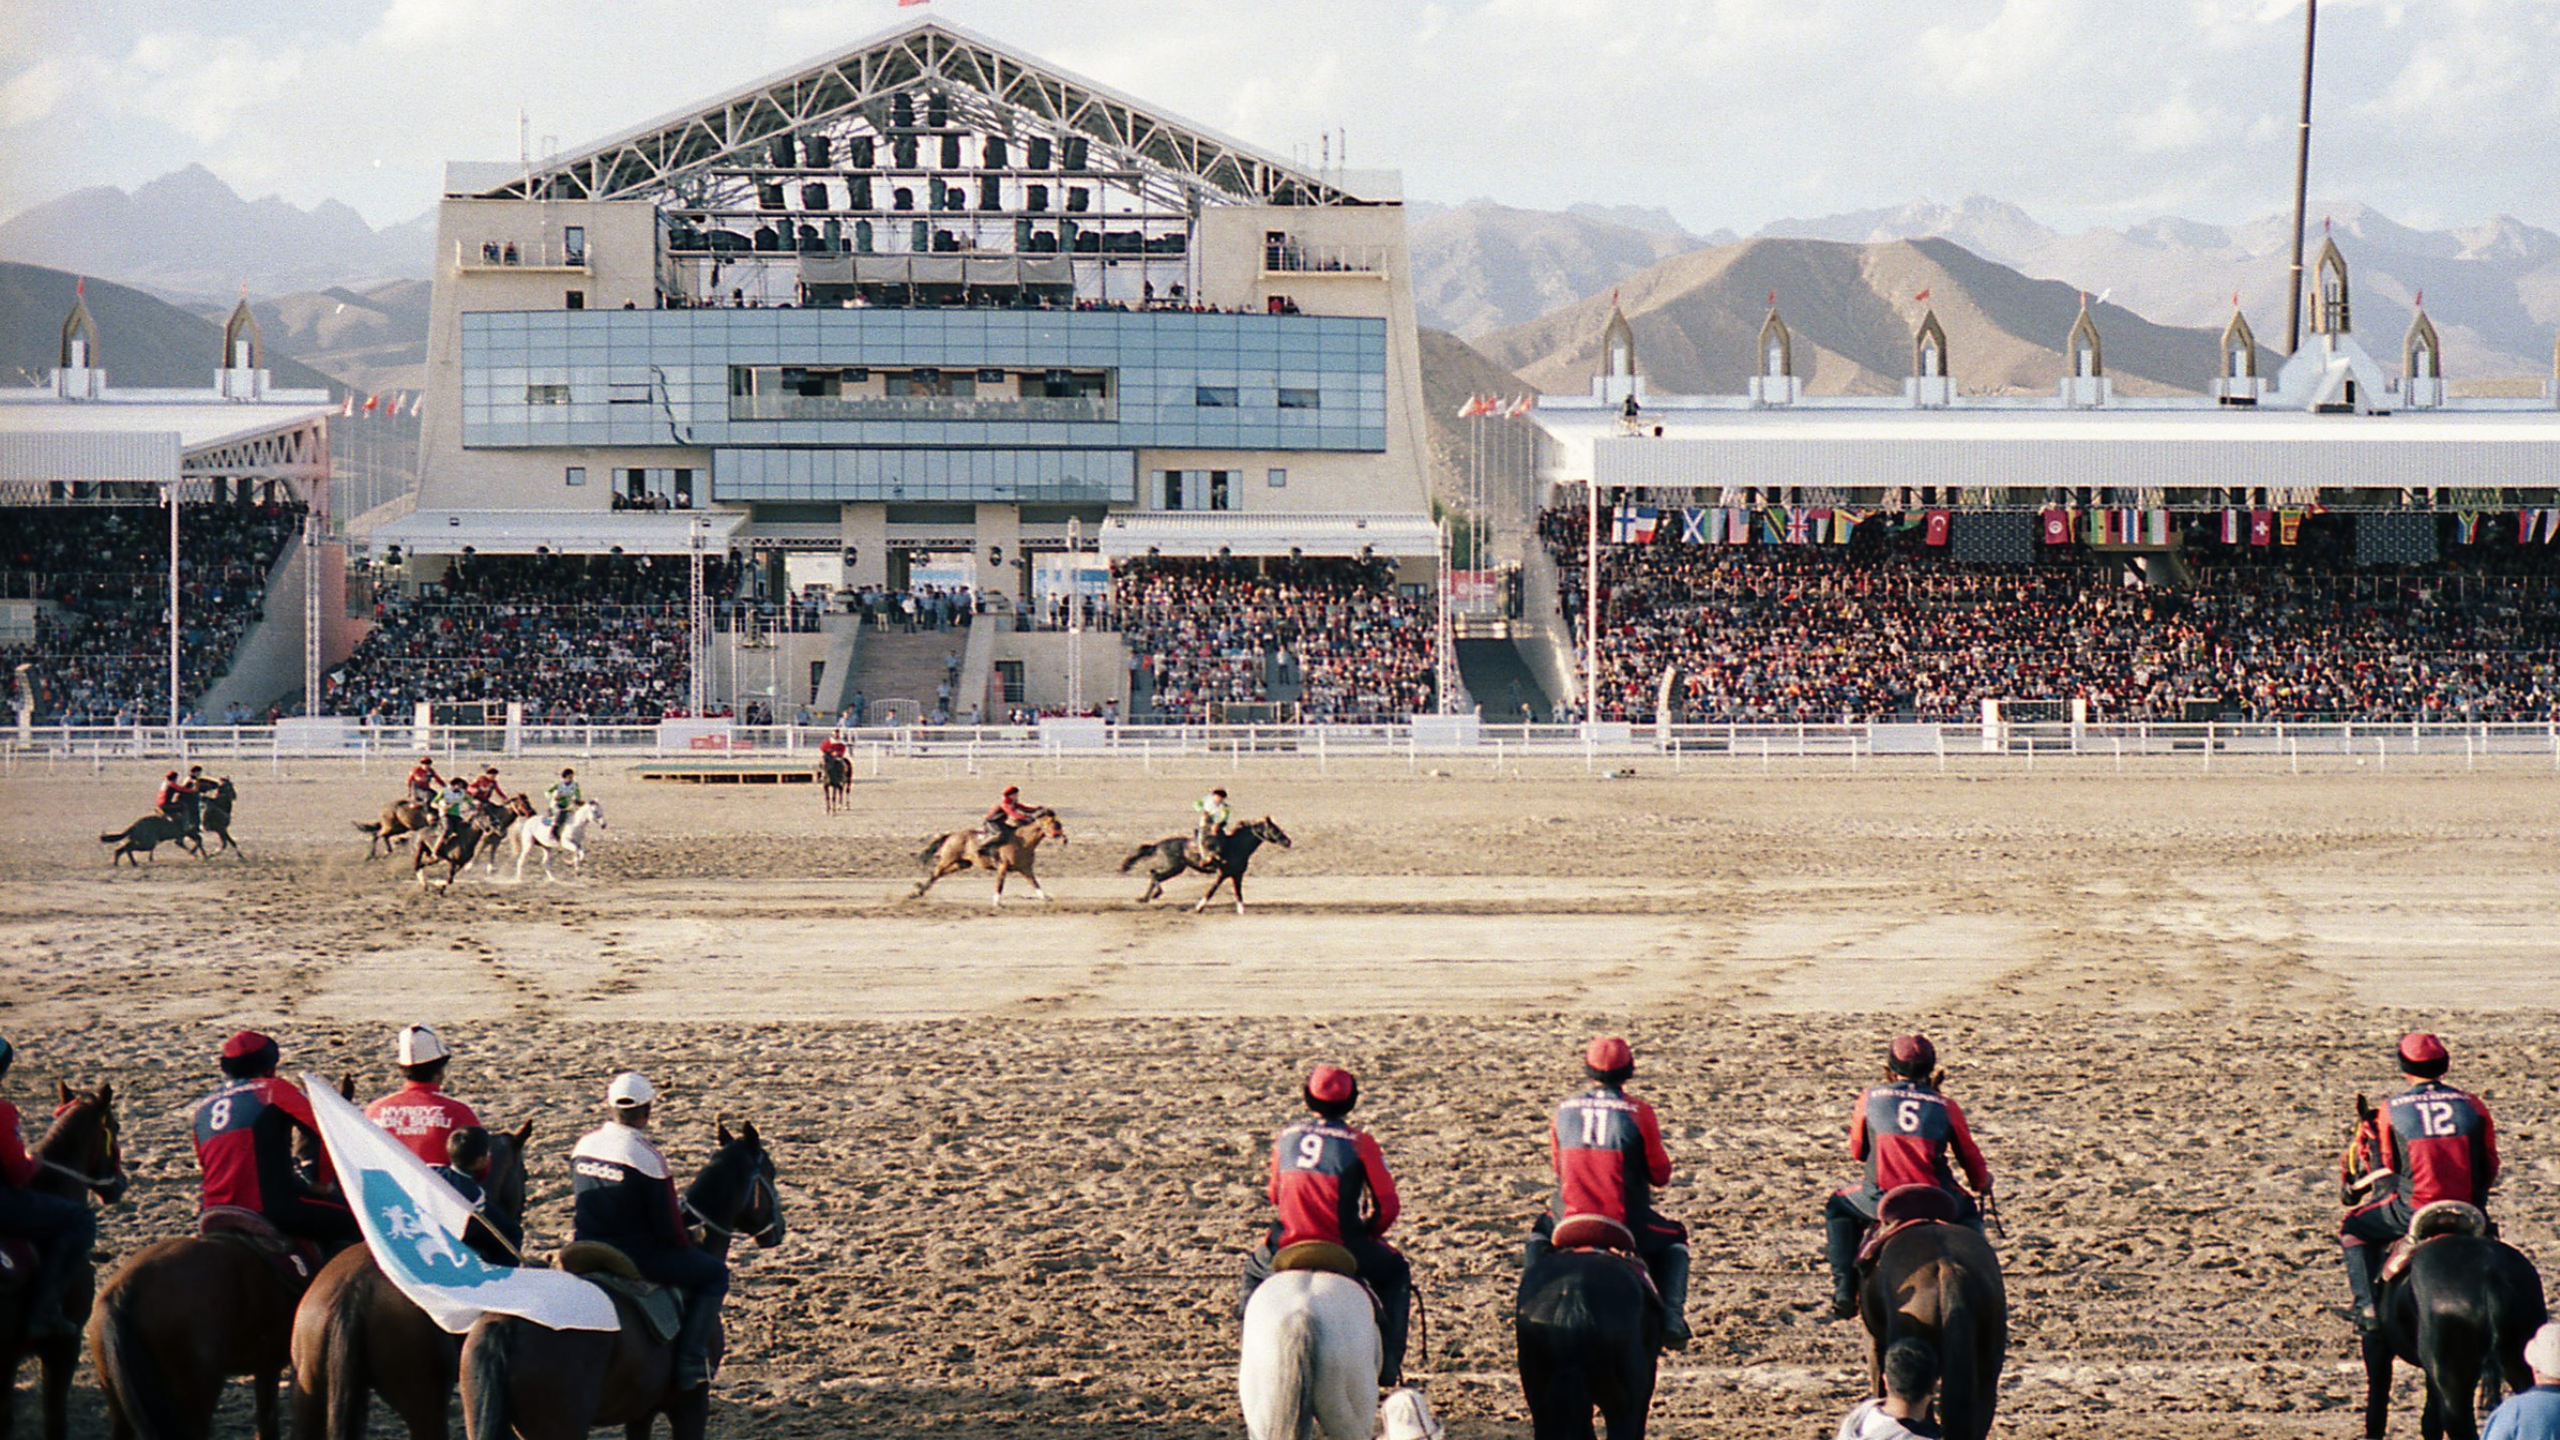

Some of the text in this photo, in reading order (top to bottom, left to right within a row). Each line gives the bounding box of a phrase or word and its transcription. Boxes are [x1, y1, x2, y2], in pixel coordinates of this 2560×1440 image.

[211, 1098, 231, 1131] 8
[1581, 1108, 1608, 1146] 11
[1898, 1100, 1920, 1132] 6
[2415, 1101, 2456, 1136] 12
[1297, 1133, 1323, 1169] 9
[577, 1162, 625, 1181] adidas
